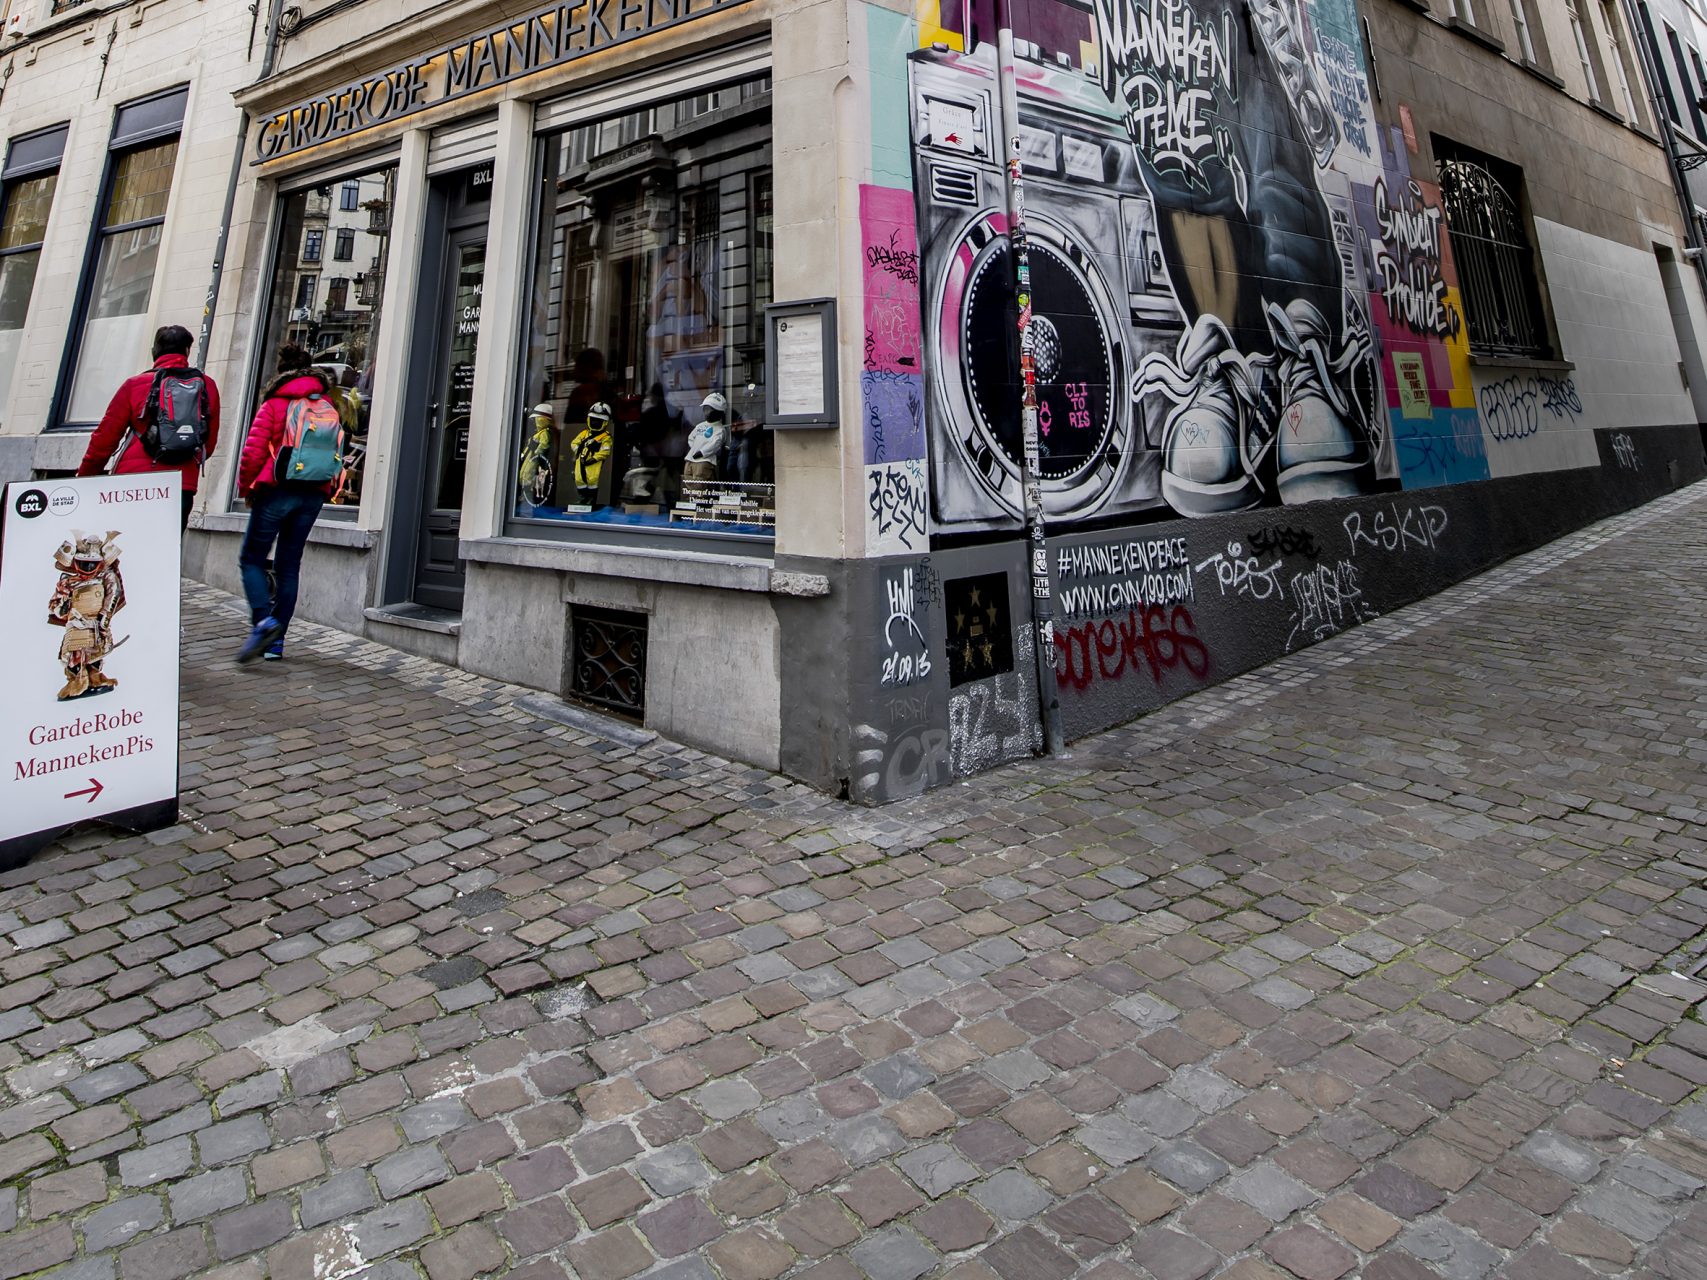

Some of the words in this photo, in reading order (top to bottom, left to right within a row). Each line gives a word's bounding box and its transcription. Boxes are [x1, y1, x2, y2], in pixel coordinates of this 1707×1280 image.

[256, 59, 431, 160] GARDEROBE
[473, 169, 493, 186] BXL
[1065, 382, 1088, 398] CLI
[1071, 398, 1085, 411] TO
[1069, 410, 1090, 428] RIS
[99, 487, 170, 505] MUSEUM
[20, 503, 42, 513] BXL
[1057, 537, 1189, 579] #MANNEKENPEACE
[1059, 564, 1195, 614] WWW.CNN199.COM
[28, 709, 143, 746] GardeRobe
[13, 734, 153, 781] MannekenPis
